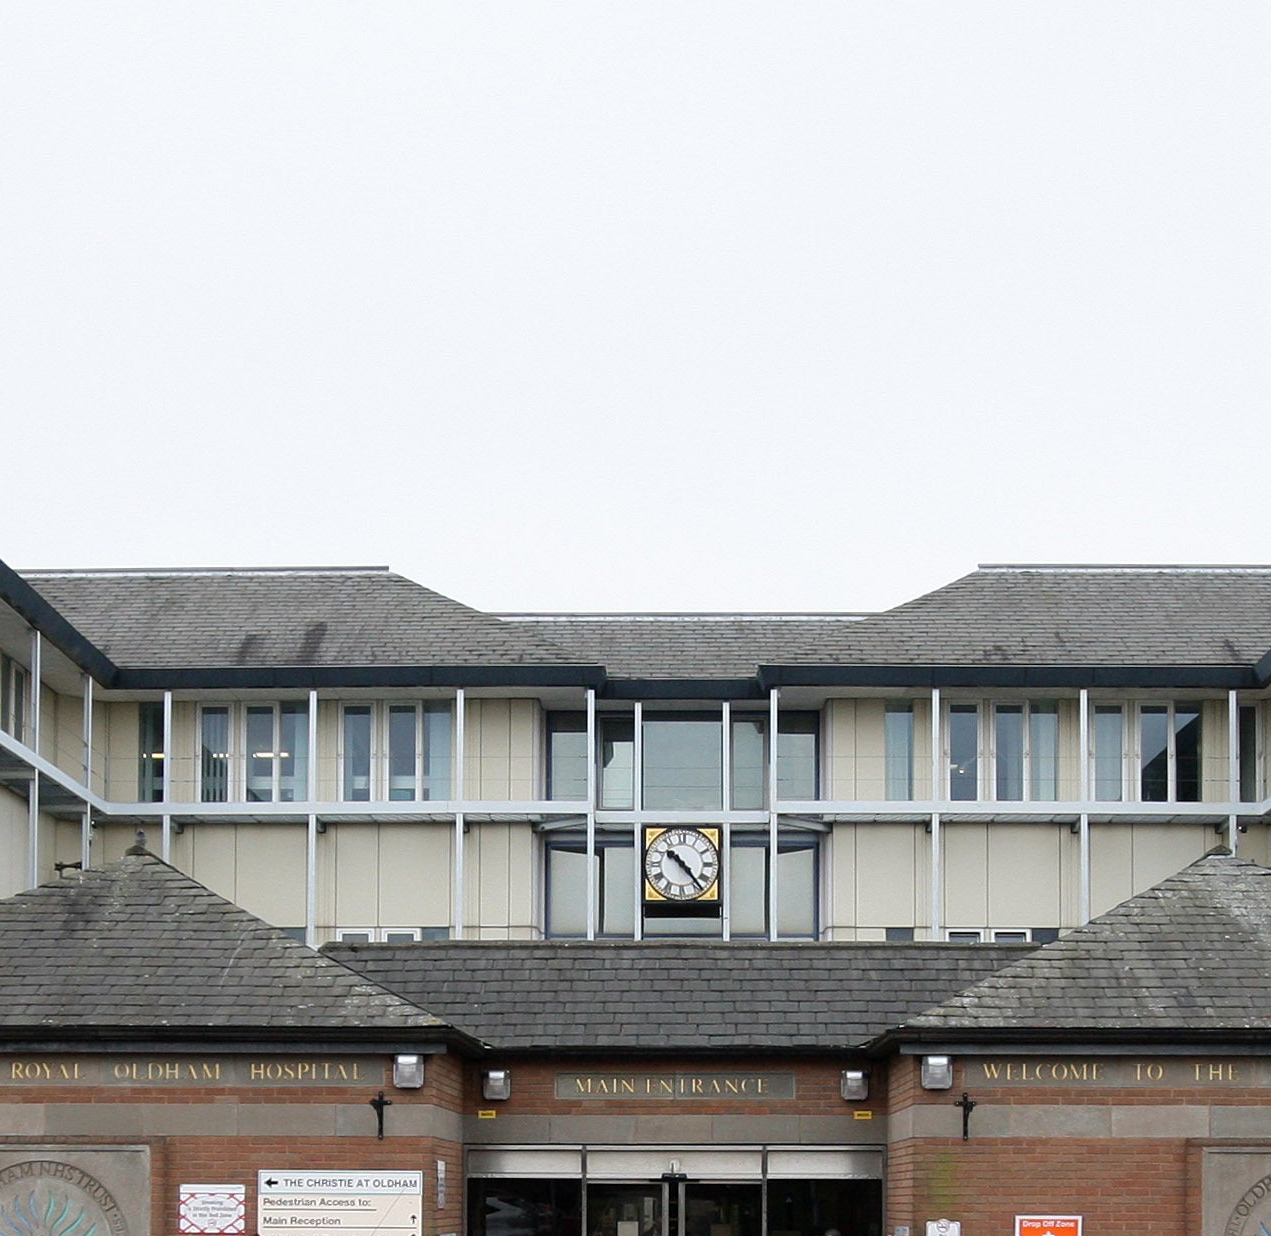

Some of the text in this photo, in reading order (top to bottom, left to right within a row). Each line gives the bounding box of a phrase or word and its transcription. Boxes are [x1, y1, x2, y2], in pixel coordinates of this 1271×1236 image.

[11, 1063, 84, 1080] ROYAL
[114, 1063, 220, 1080] OLDHAM
[250, 1063, 364, 1080] HOSPITAL
[983, 1063, 1103, 1080] WELCOME
[1133, 1063, 1163, 1080] TO
[1194, 1063, 1238, 1080] THE
[576, 1078, 769, 1094] MAIN ENTRANCE
[38, 1163, 75, 1181] NHS
[75, 1170, 117, 1213] TRUST
[284, 1178, 418, 1188] THE CHRISTIE AT OLDHAM
[263, 1198, 372, 1206] Pedestrian Access to:
[263, 1216, 341, 1227] Main Reception
[1022, 1220, 1041, 1228] Drop
